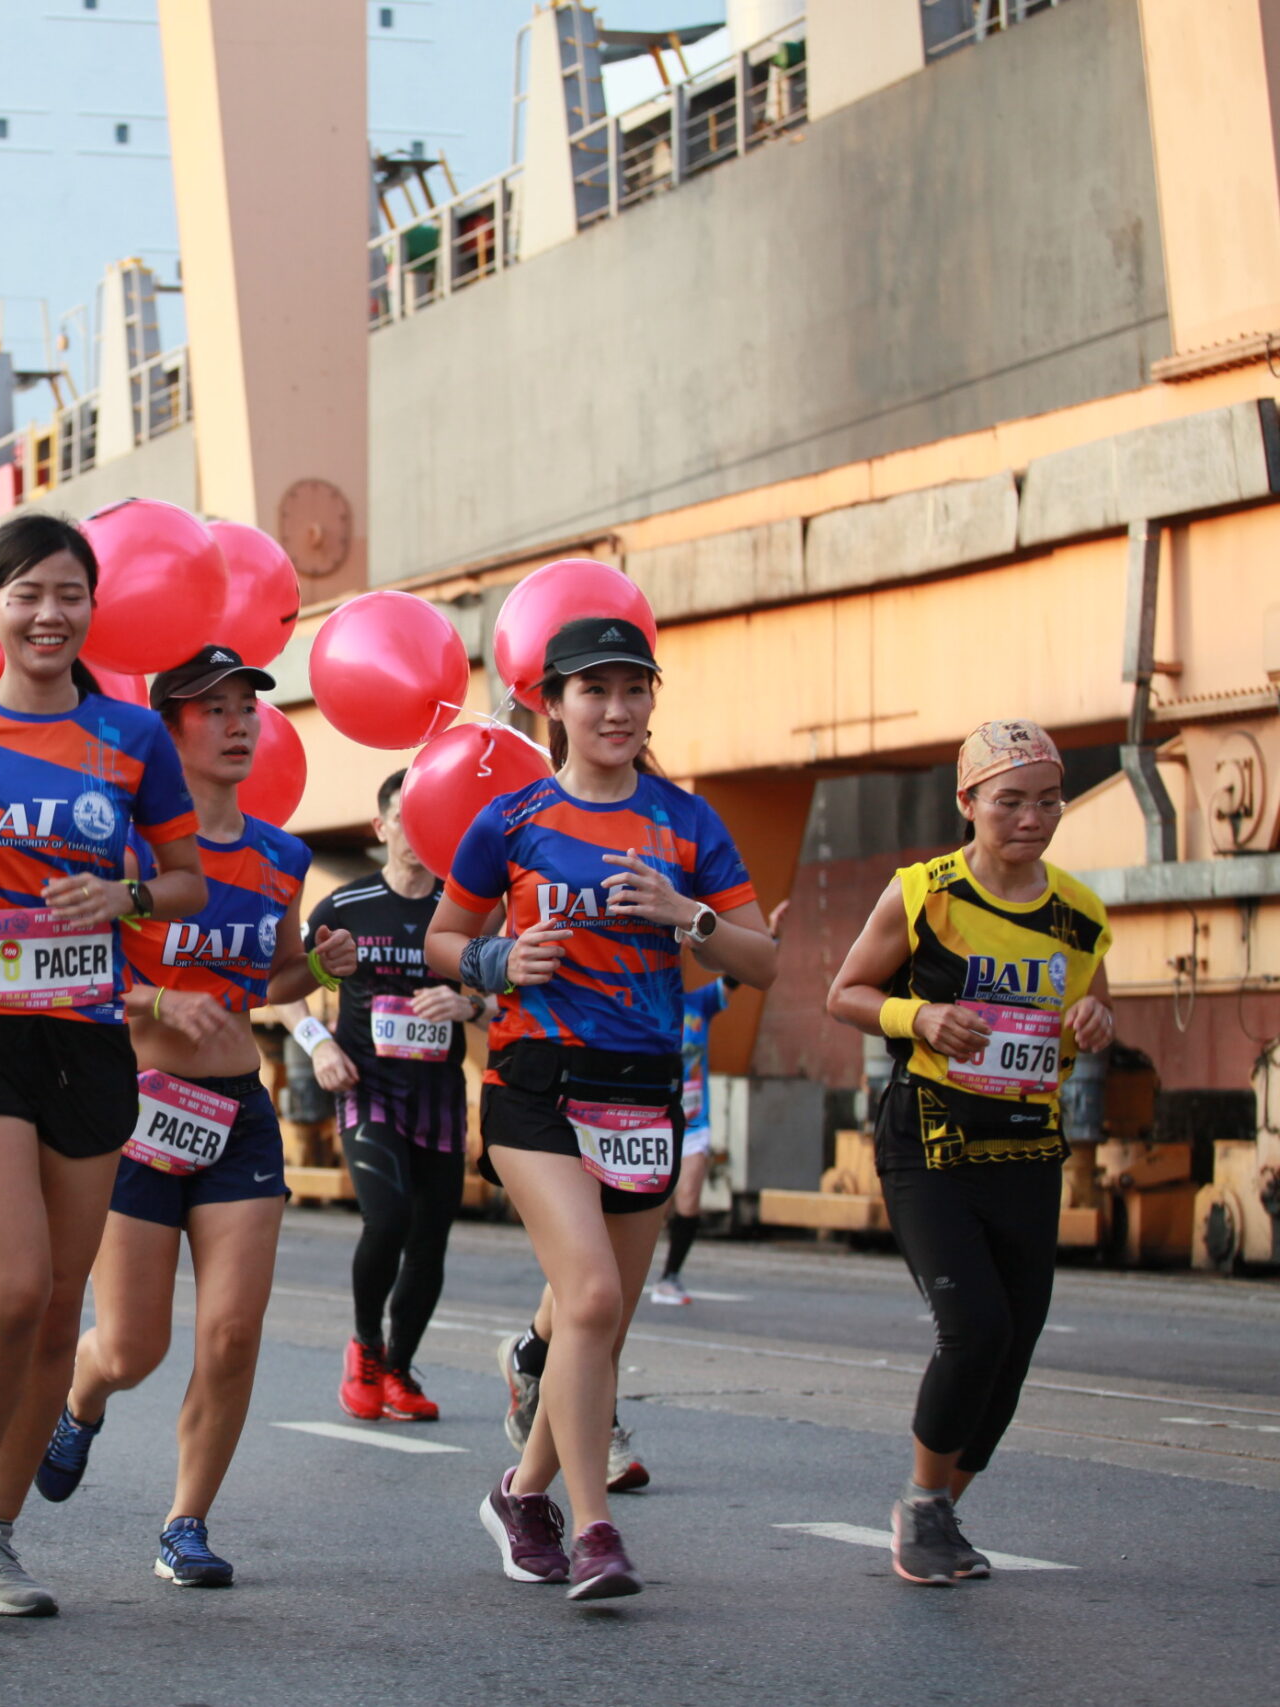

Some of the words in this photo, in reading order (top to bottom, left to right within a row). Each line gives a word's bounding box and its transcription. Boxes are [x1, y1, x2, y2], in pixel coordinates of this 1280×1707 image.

[51, 840, 64, 848] OF
[67, 842, 108, 855] THAILAND
[161, 922, 254, 966] PAT
[357, 936, 393, 946] SATIT
[34, 944, 107, 980] PACER
[357, 946, 426, 964] PATUM
[962, 955, 1048, 999] PAT
[375, 1020, 395, 1039] 50
[407, 1022, 447, 1044] 0236
[1024, 1023, 1036, 1031] MAY
[1000, 1041, 1056, 1074] 0576
[187, 1099, 200, 1111] MAY
[147, 1109, 221, 1161] PACER
[599, 1136, 669, 1166] PACER
